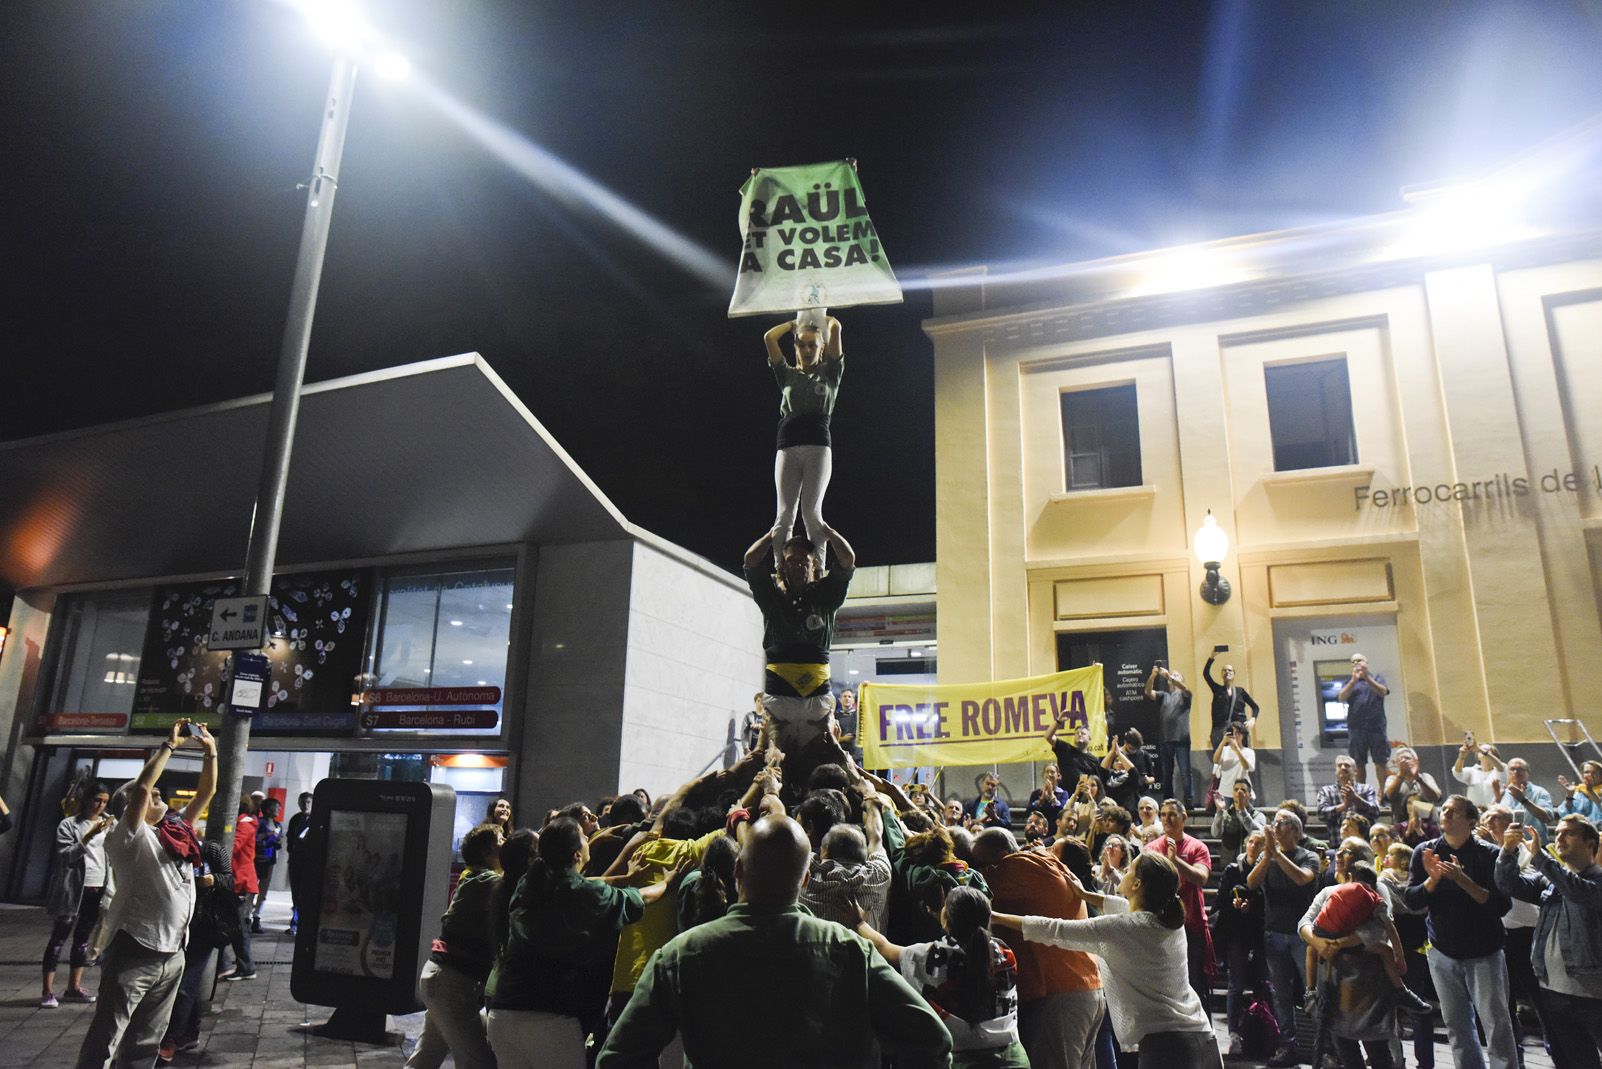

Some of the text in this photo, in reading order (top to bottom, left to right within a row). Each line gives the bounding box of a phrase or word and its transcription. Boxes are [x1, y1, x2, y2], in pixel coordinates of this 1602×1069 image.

[748, 182, 870, 228] RAÜL
[777, 220, 876, 245] VOLEM
[740, 239, 881, 273] A CASA!
[1354, 464, 1602, 511] Ferrocarrils de l
[211, 628, 259, 642] C. ANDANA
[1311, 635, 1338, 646] ING
[366, 714, 380, 727] S7
[399, 714, 445, 727] Barcelona
[879, 702, 950, 741] FREE
[960, 690, 1089, 737] ROMEVA
